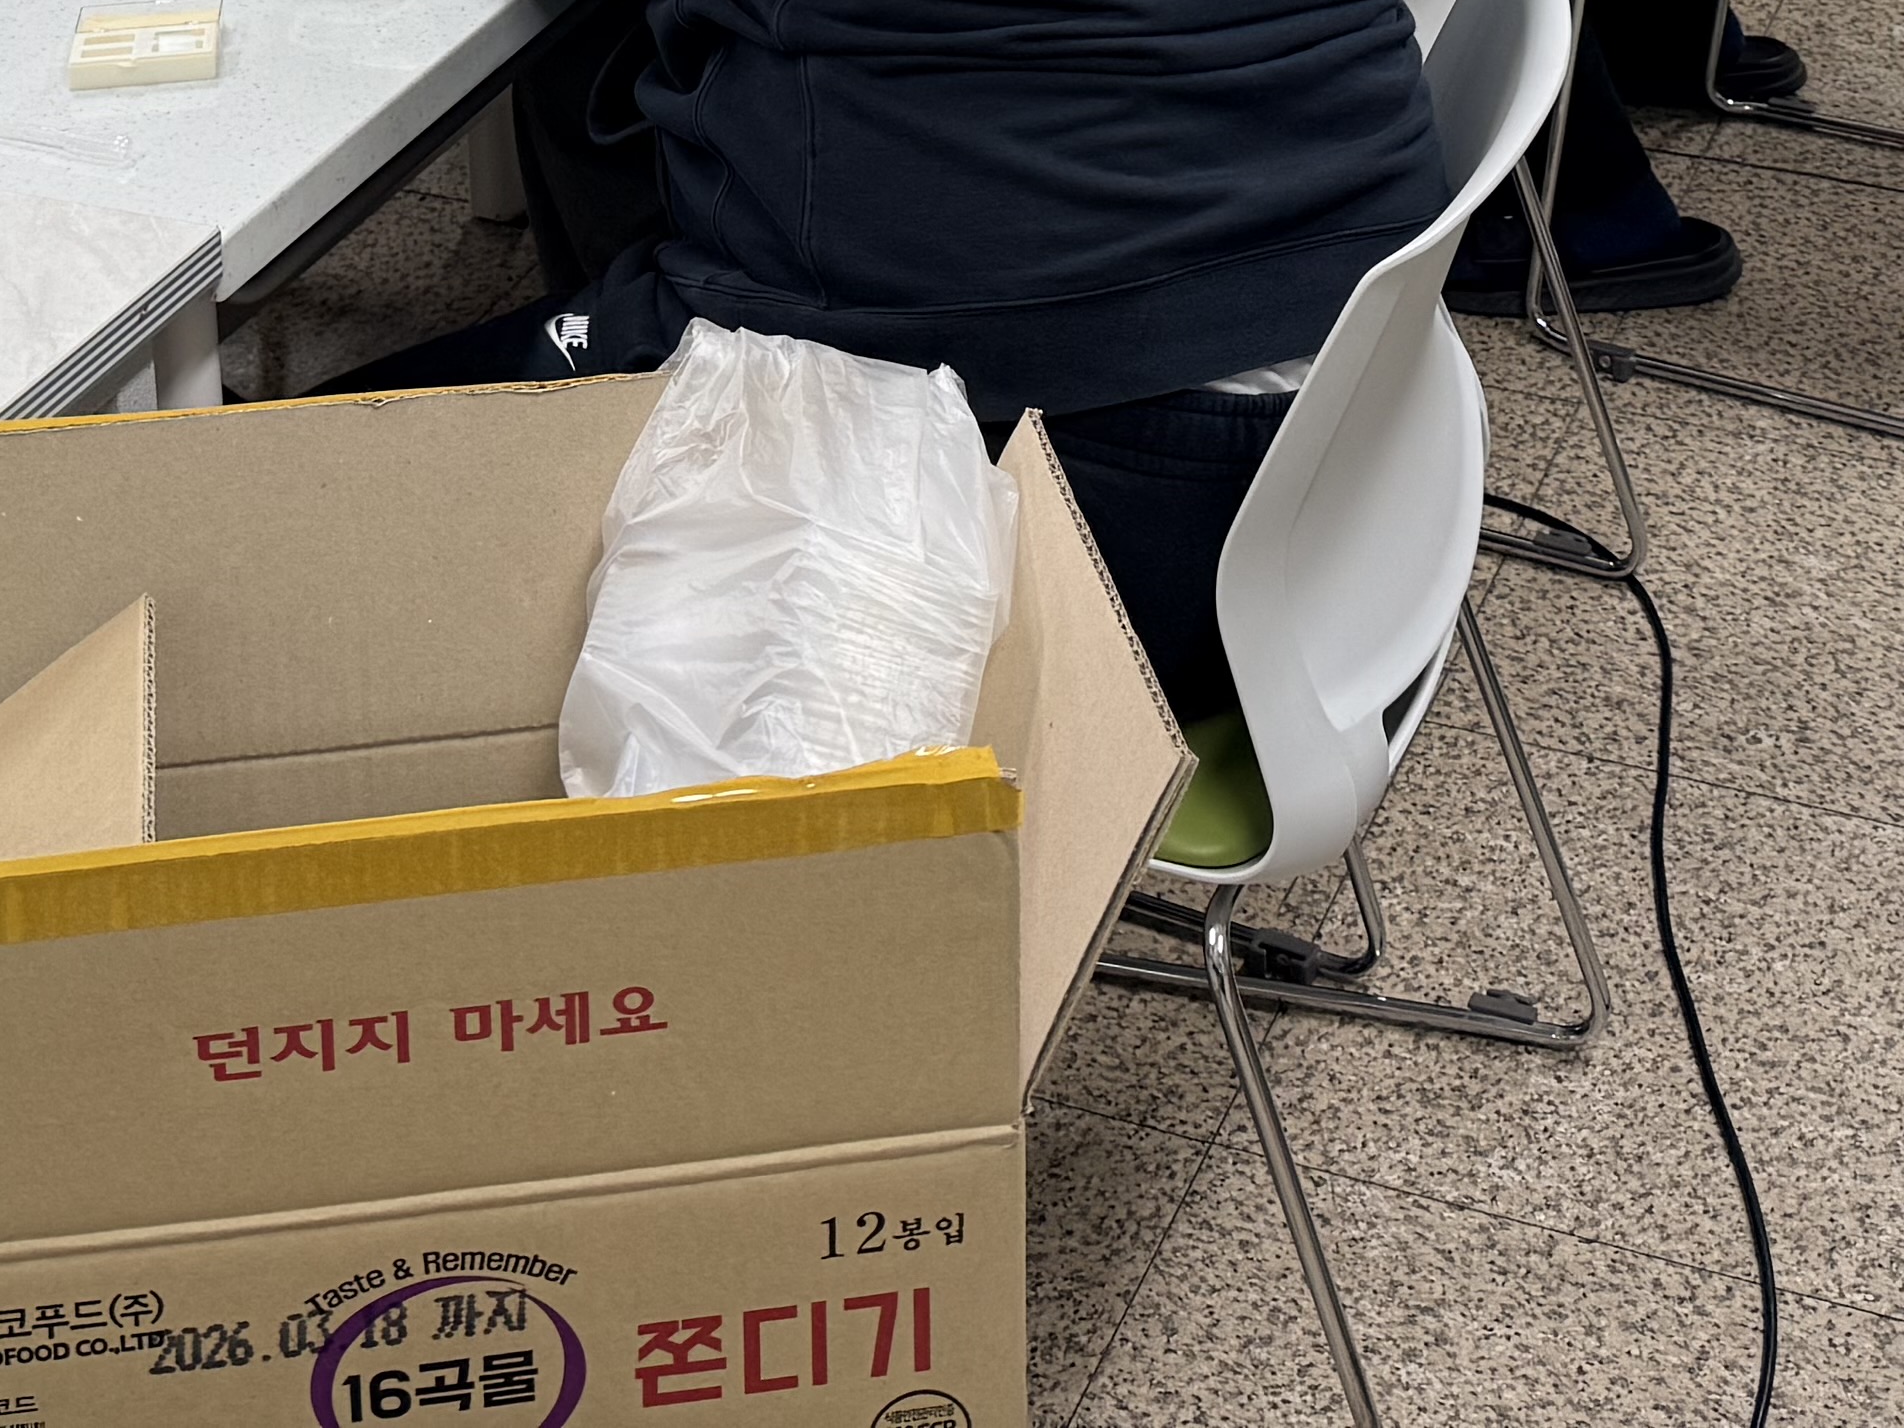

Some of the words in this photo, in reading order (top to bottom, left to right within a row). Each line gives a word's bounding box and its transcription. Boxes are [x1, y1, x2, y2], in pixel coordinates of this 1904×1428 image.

[560, 315, 590, 350] NIKE
[193, 1010, 411, 1082] 던지지
[449, 986, 669, 1053] 마세요
[821, 1211, 965, 1260] 12봉입
[304, 1268, 386, 1316] Taste
[392, 1258, 414, 1280] &
[423, 1250, 578, 1286] Remember
[635, 1286, 931, 1408] 쫀디기
[342, 1349, 539, 1424] 16곡물
